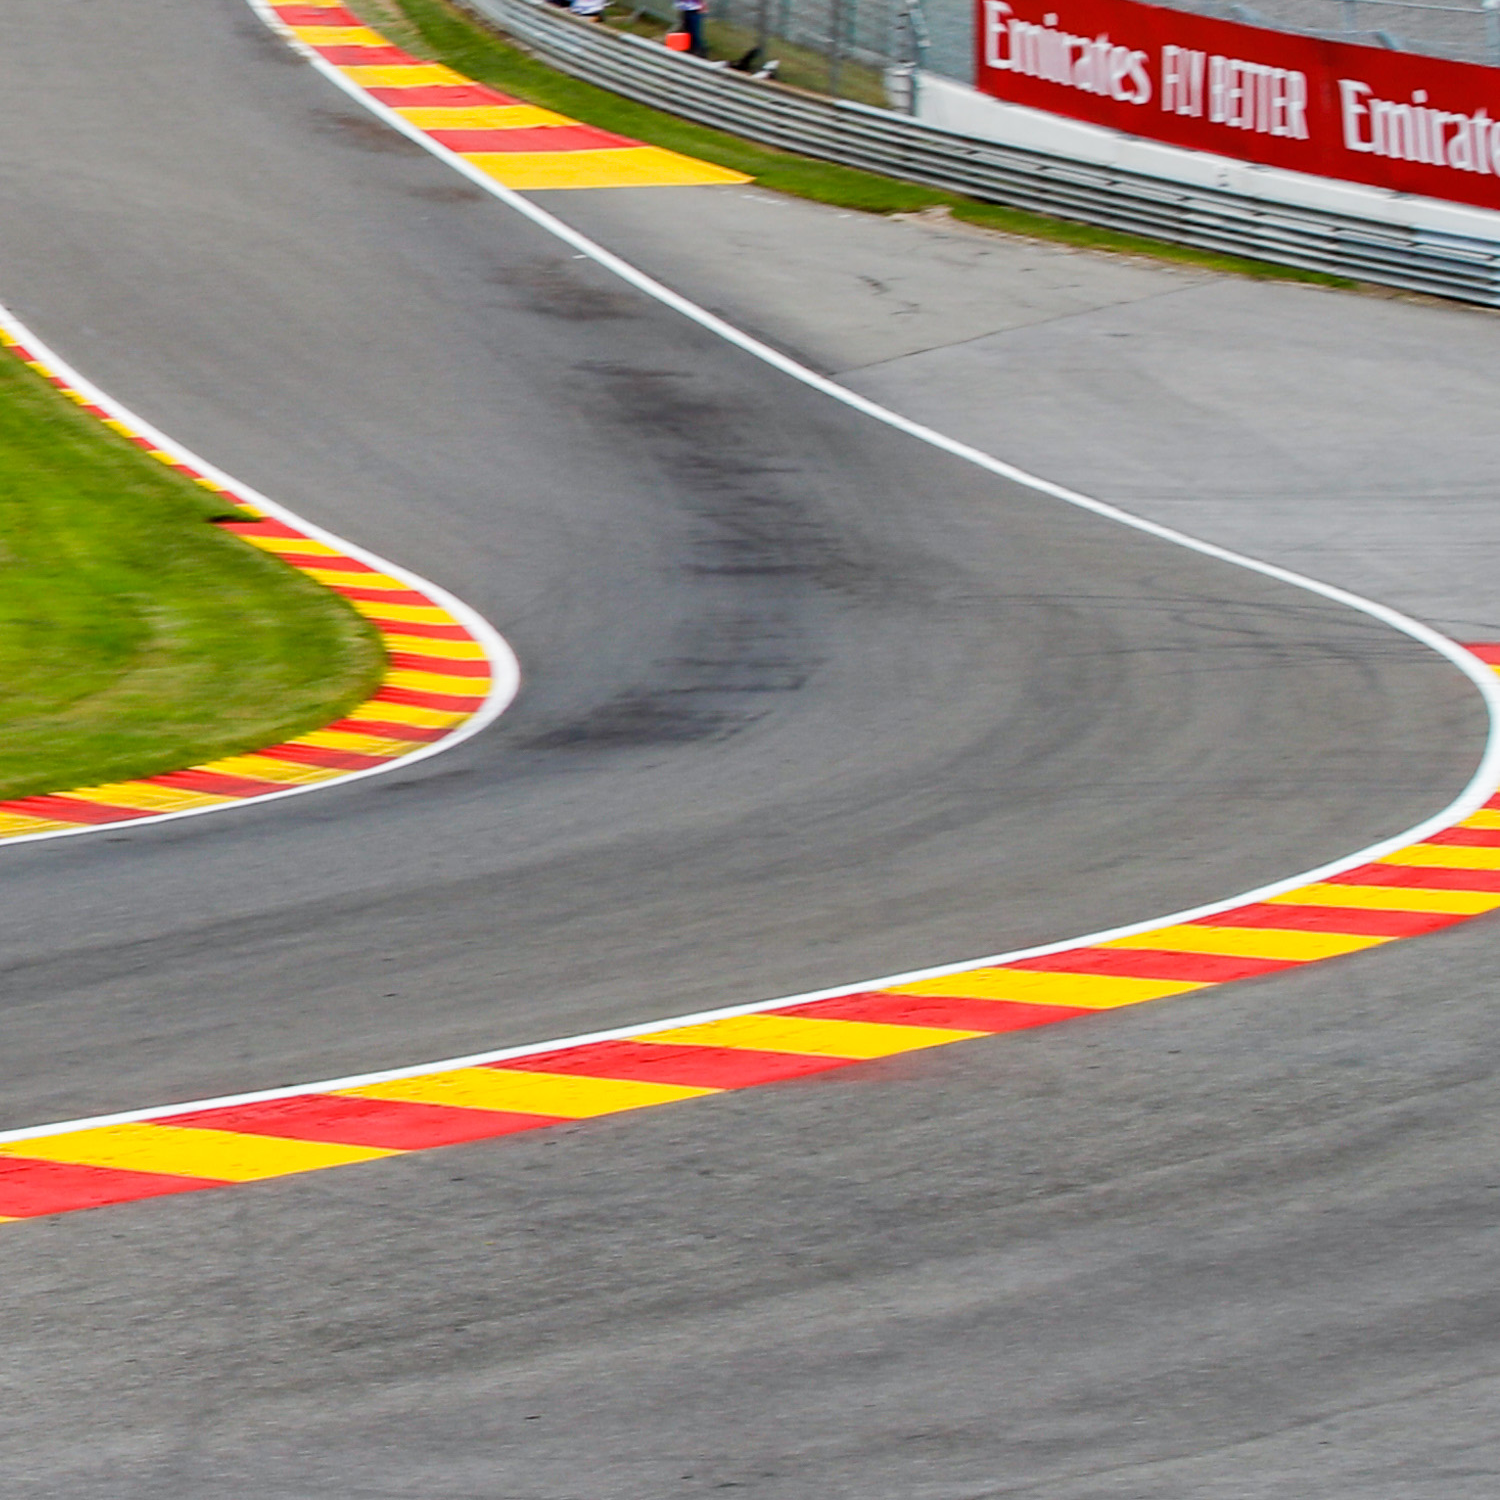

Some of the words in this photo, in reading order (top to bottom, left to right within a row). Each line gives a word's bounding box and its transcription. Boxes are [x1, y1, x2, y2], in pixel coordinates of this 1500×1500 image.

[983, 0, 1152, 105] Emirates
[1160, 44, 1207, 118] FLY
[1208, 55, 1309, 140] BETTER
